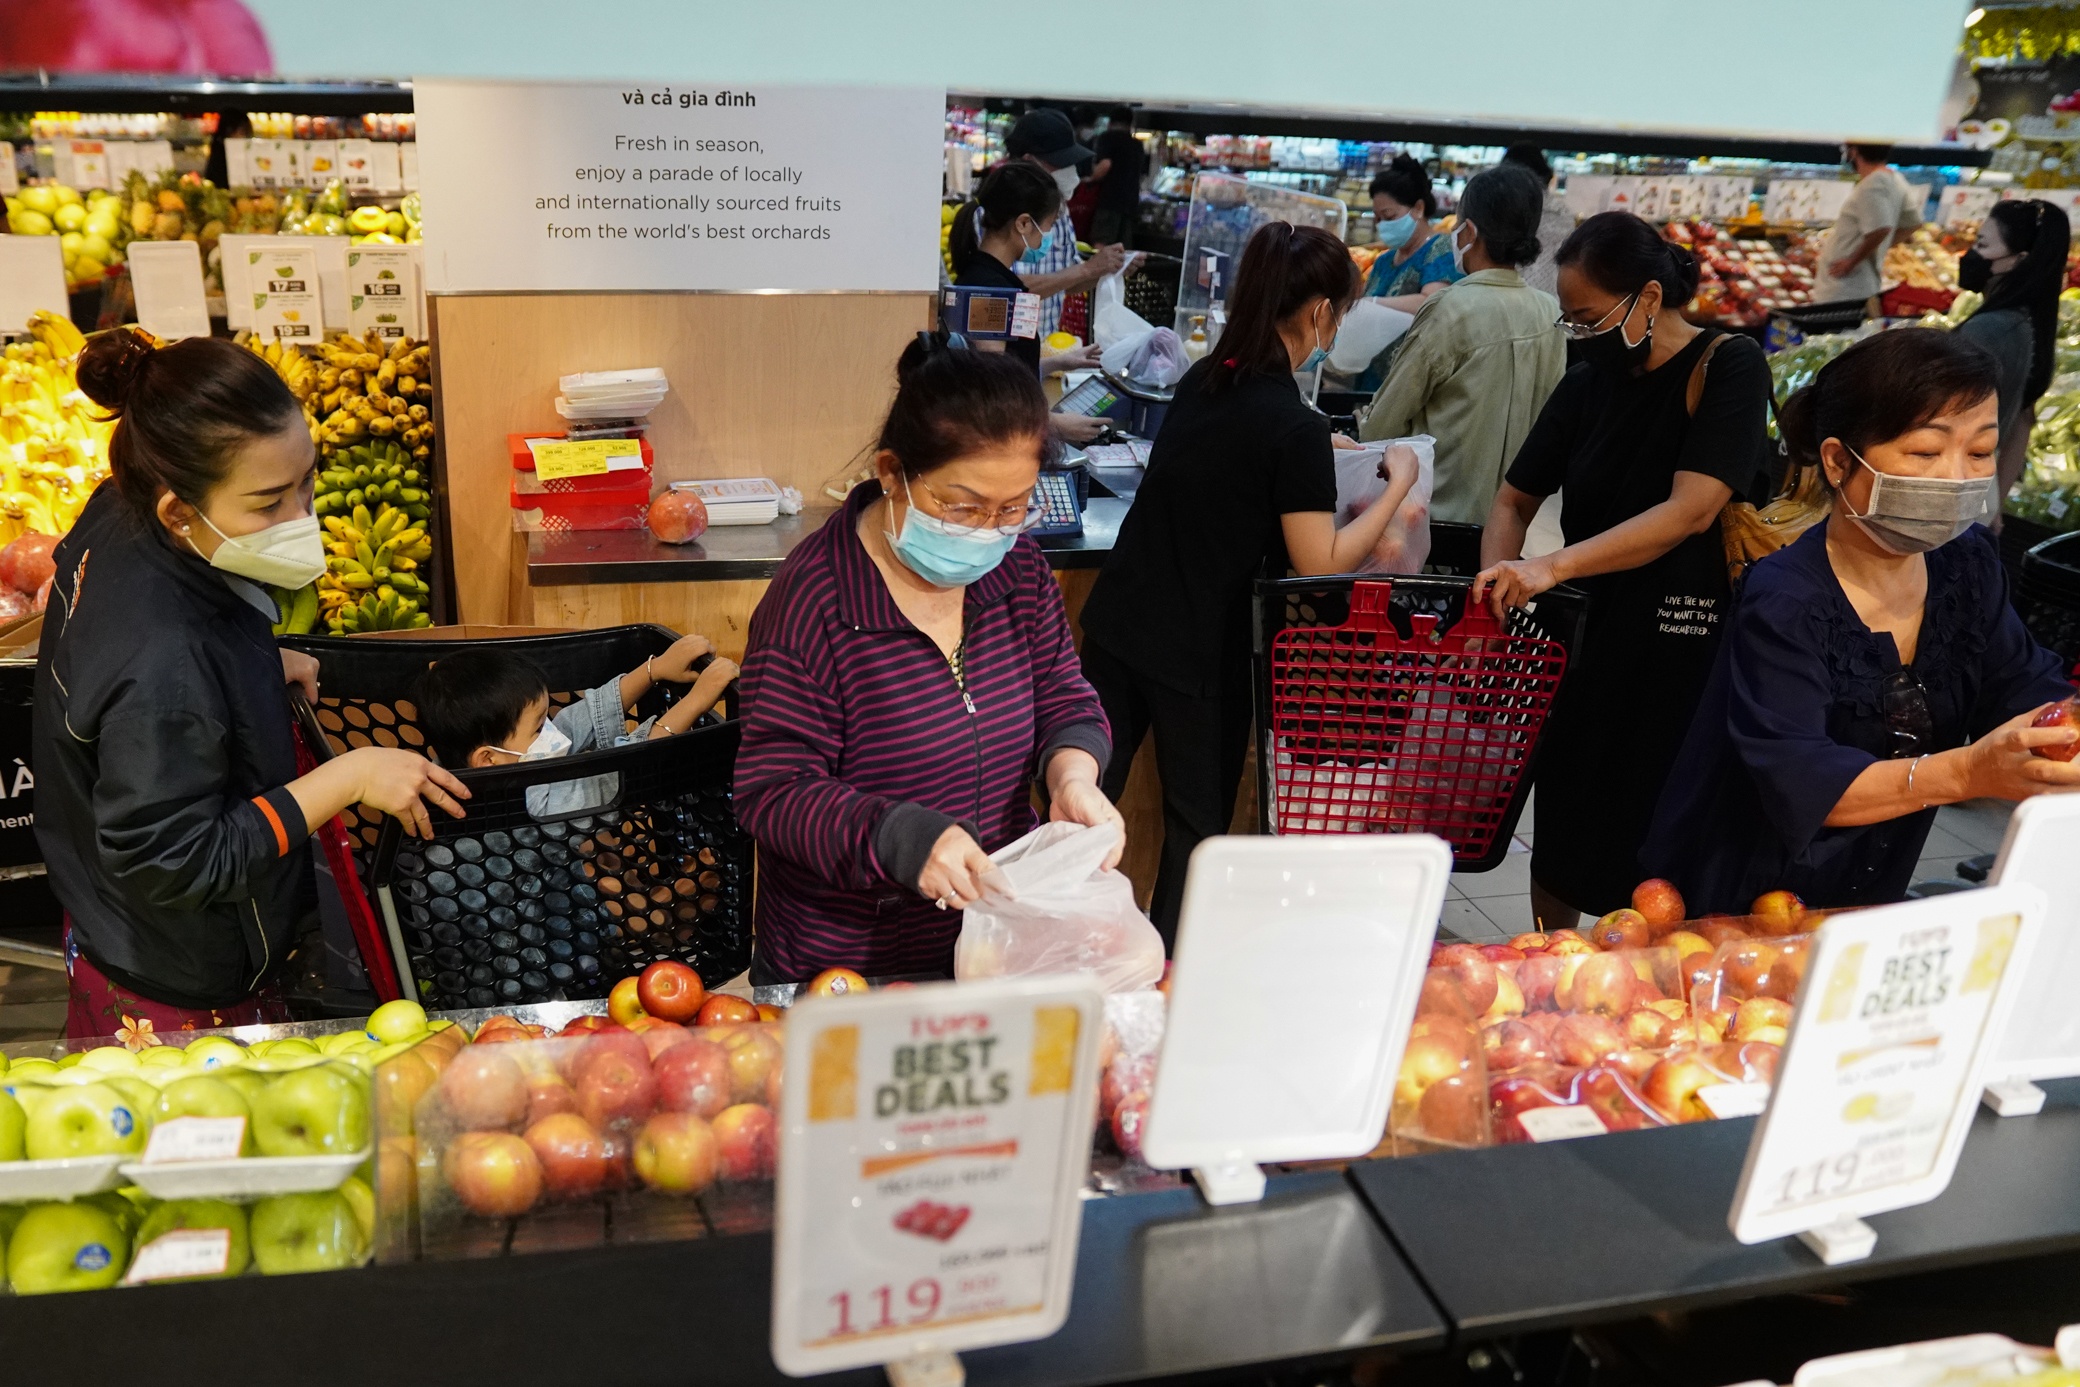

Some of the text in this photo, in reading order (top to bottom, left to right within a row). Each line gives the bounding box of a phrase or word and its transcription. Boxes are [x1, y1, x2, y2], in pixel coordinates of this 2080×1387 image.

[622, 88, 756, 109] và cả gia đình
[615, 135, 764, 155] Fresh in season,
[575, 164, 803, 185] enjoy a parade of locally
[535, 193, 841, 213] and internationally sourced fruits
[547, 222, 831, 240] from the world's best orchards
[368, 284, 385, 295] 16
[1664, 595, 1715, 607] LIVE THE WAY
[1656, 607, 1718, 622] YOU WANT TO BE
[1879, 946, 1952, 986] BEST
[1860, 975, 1951, 1020] DEALS
[893, 1036, 999, 1080] BEST
[874, 1070, 1011, 1119] DEALS
[828, 1276, 943, 1337] 119
